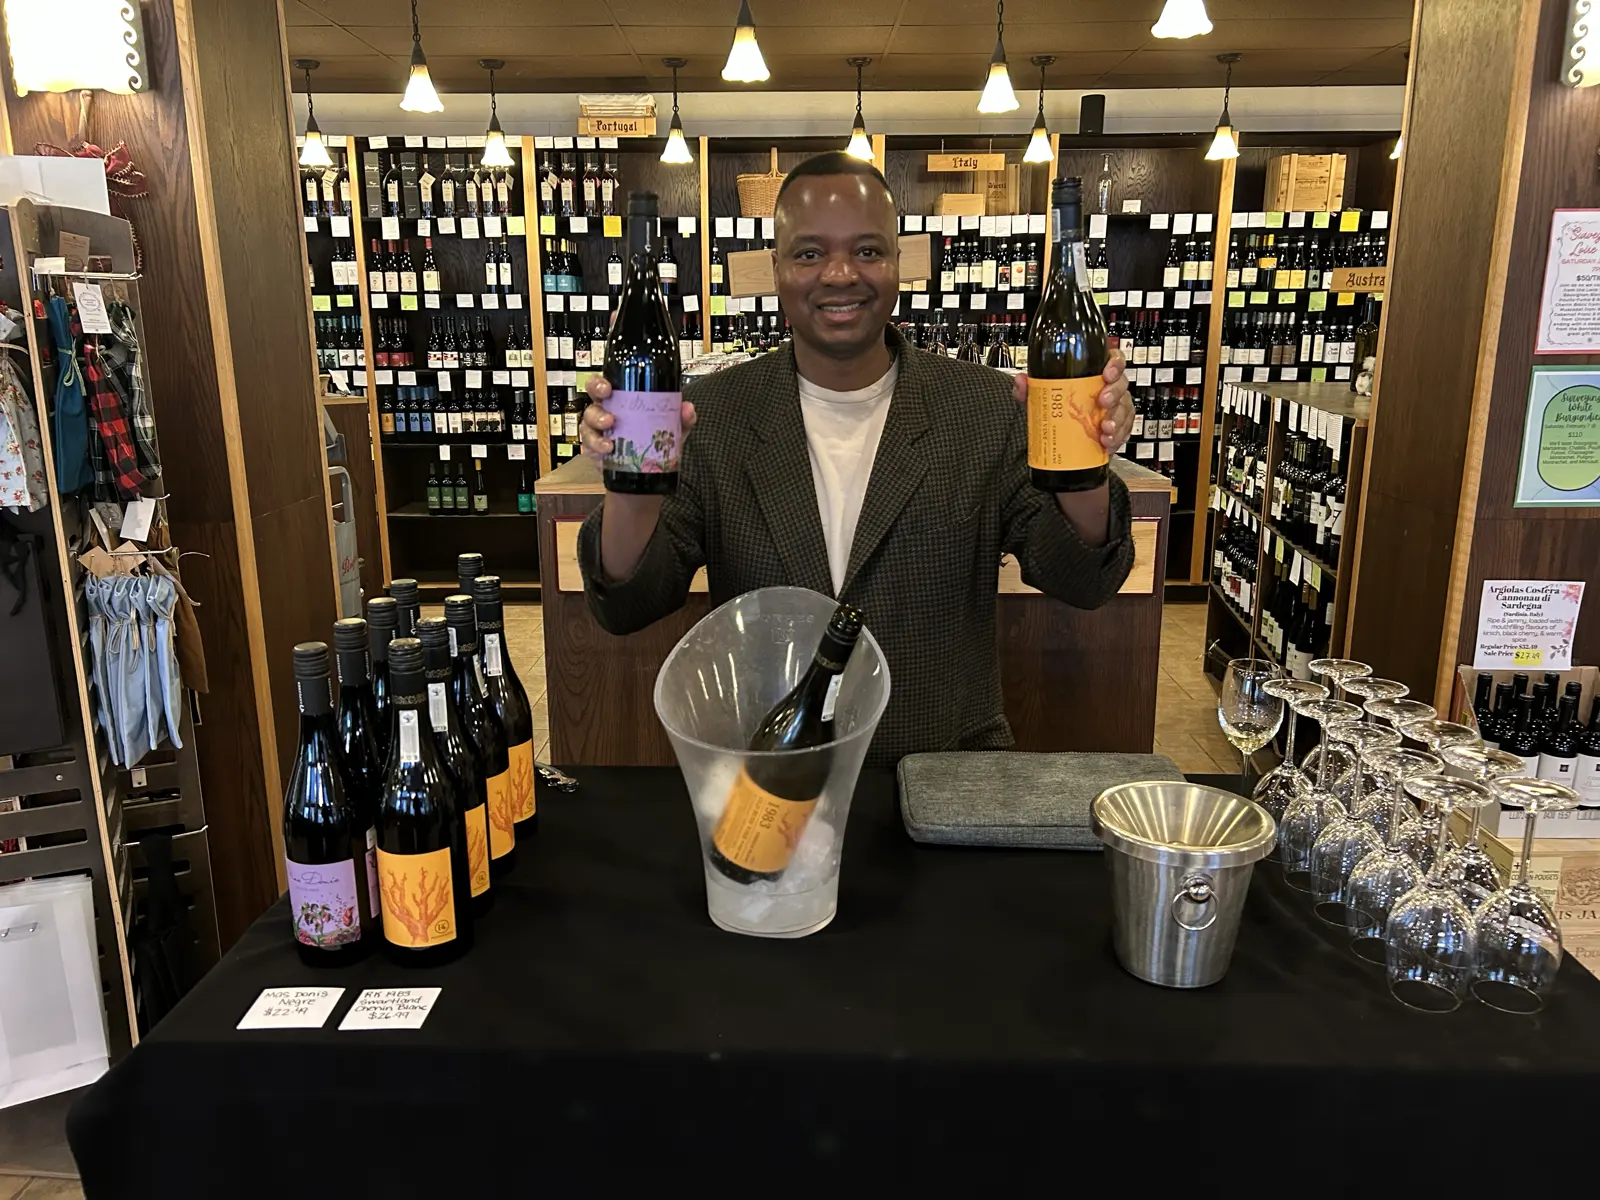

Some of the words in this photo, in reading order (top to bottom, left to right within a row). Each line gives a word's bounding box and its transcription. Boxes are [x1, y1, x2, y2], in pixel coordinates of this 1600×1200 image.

[596, 120, 637, 132] Portugal
[952, 157, 978, 168] Italy
[1051, 387, 1063, 418] 1983
[1568, 401, 1592, 411] White
[1488, 585, 1524, 595] Argiolas
[1525, 585, 1560, 594] Costera
[1496, 594, 1540, 602] Cannonau
[1542, 594, 1551, 602] di
[1501, 602, 1542, 611] Sardegna
[760, 801, 780, 829] 1983
[278, 999, 316, 1008] Negre
[359, 996, 423, 1005] Swartland
[355, 1004, 393, 1012] Chenin
[397, 1003, 428, 1011] Blanc
